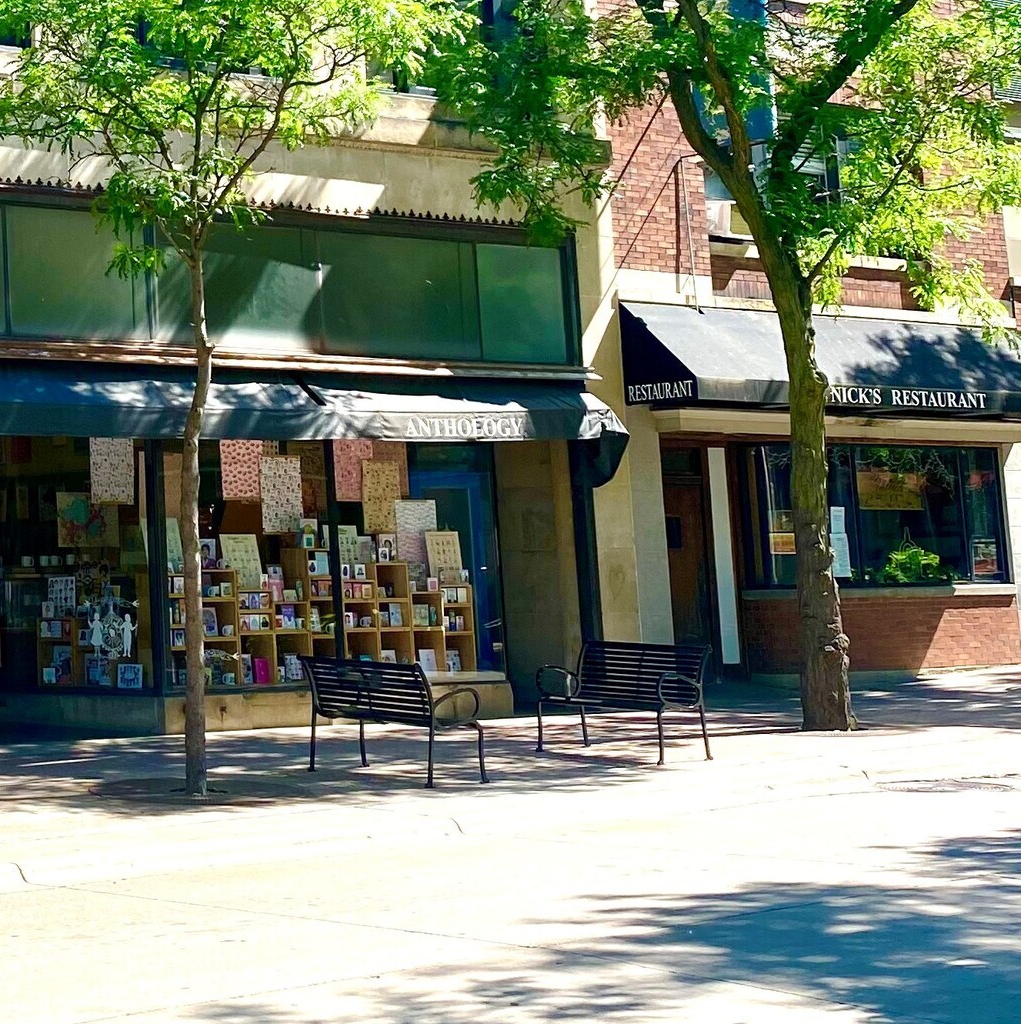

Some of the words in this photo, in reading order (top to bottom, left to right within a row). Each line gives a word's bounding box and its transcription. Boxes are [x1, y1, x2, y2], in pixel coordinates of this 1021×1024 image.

[628, 380, 693, 401] RESTAURANT
[829, 386, 882, 404] NICK'S
[891, 389, 986, 409] RESTAURANT
[405, 417, 523, 437] ANTHOLOGY
